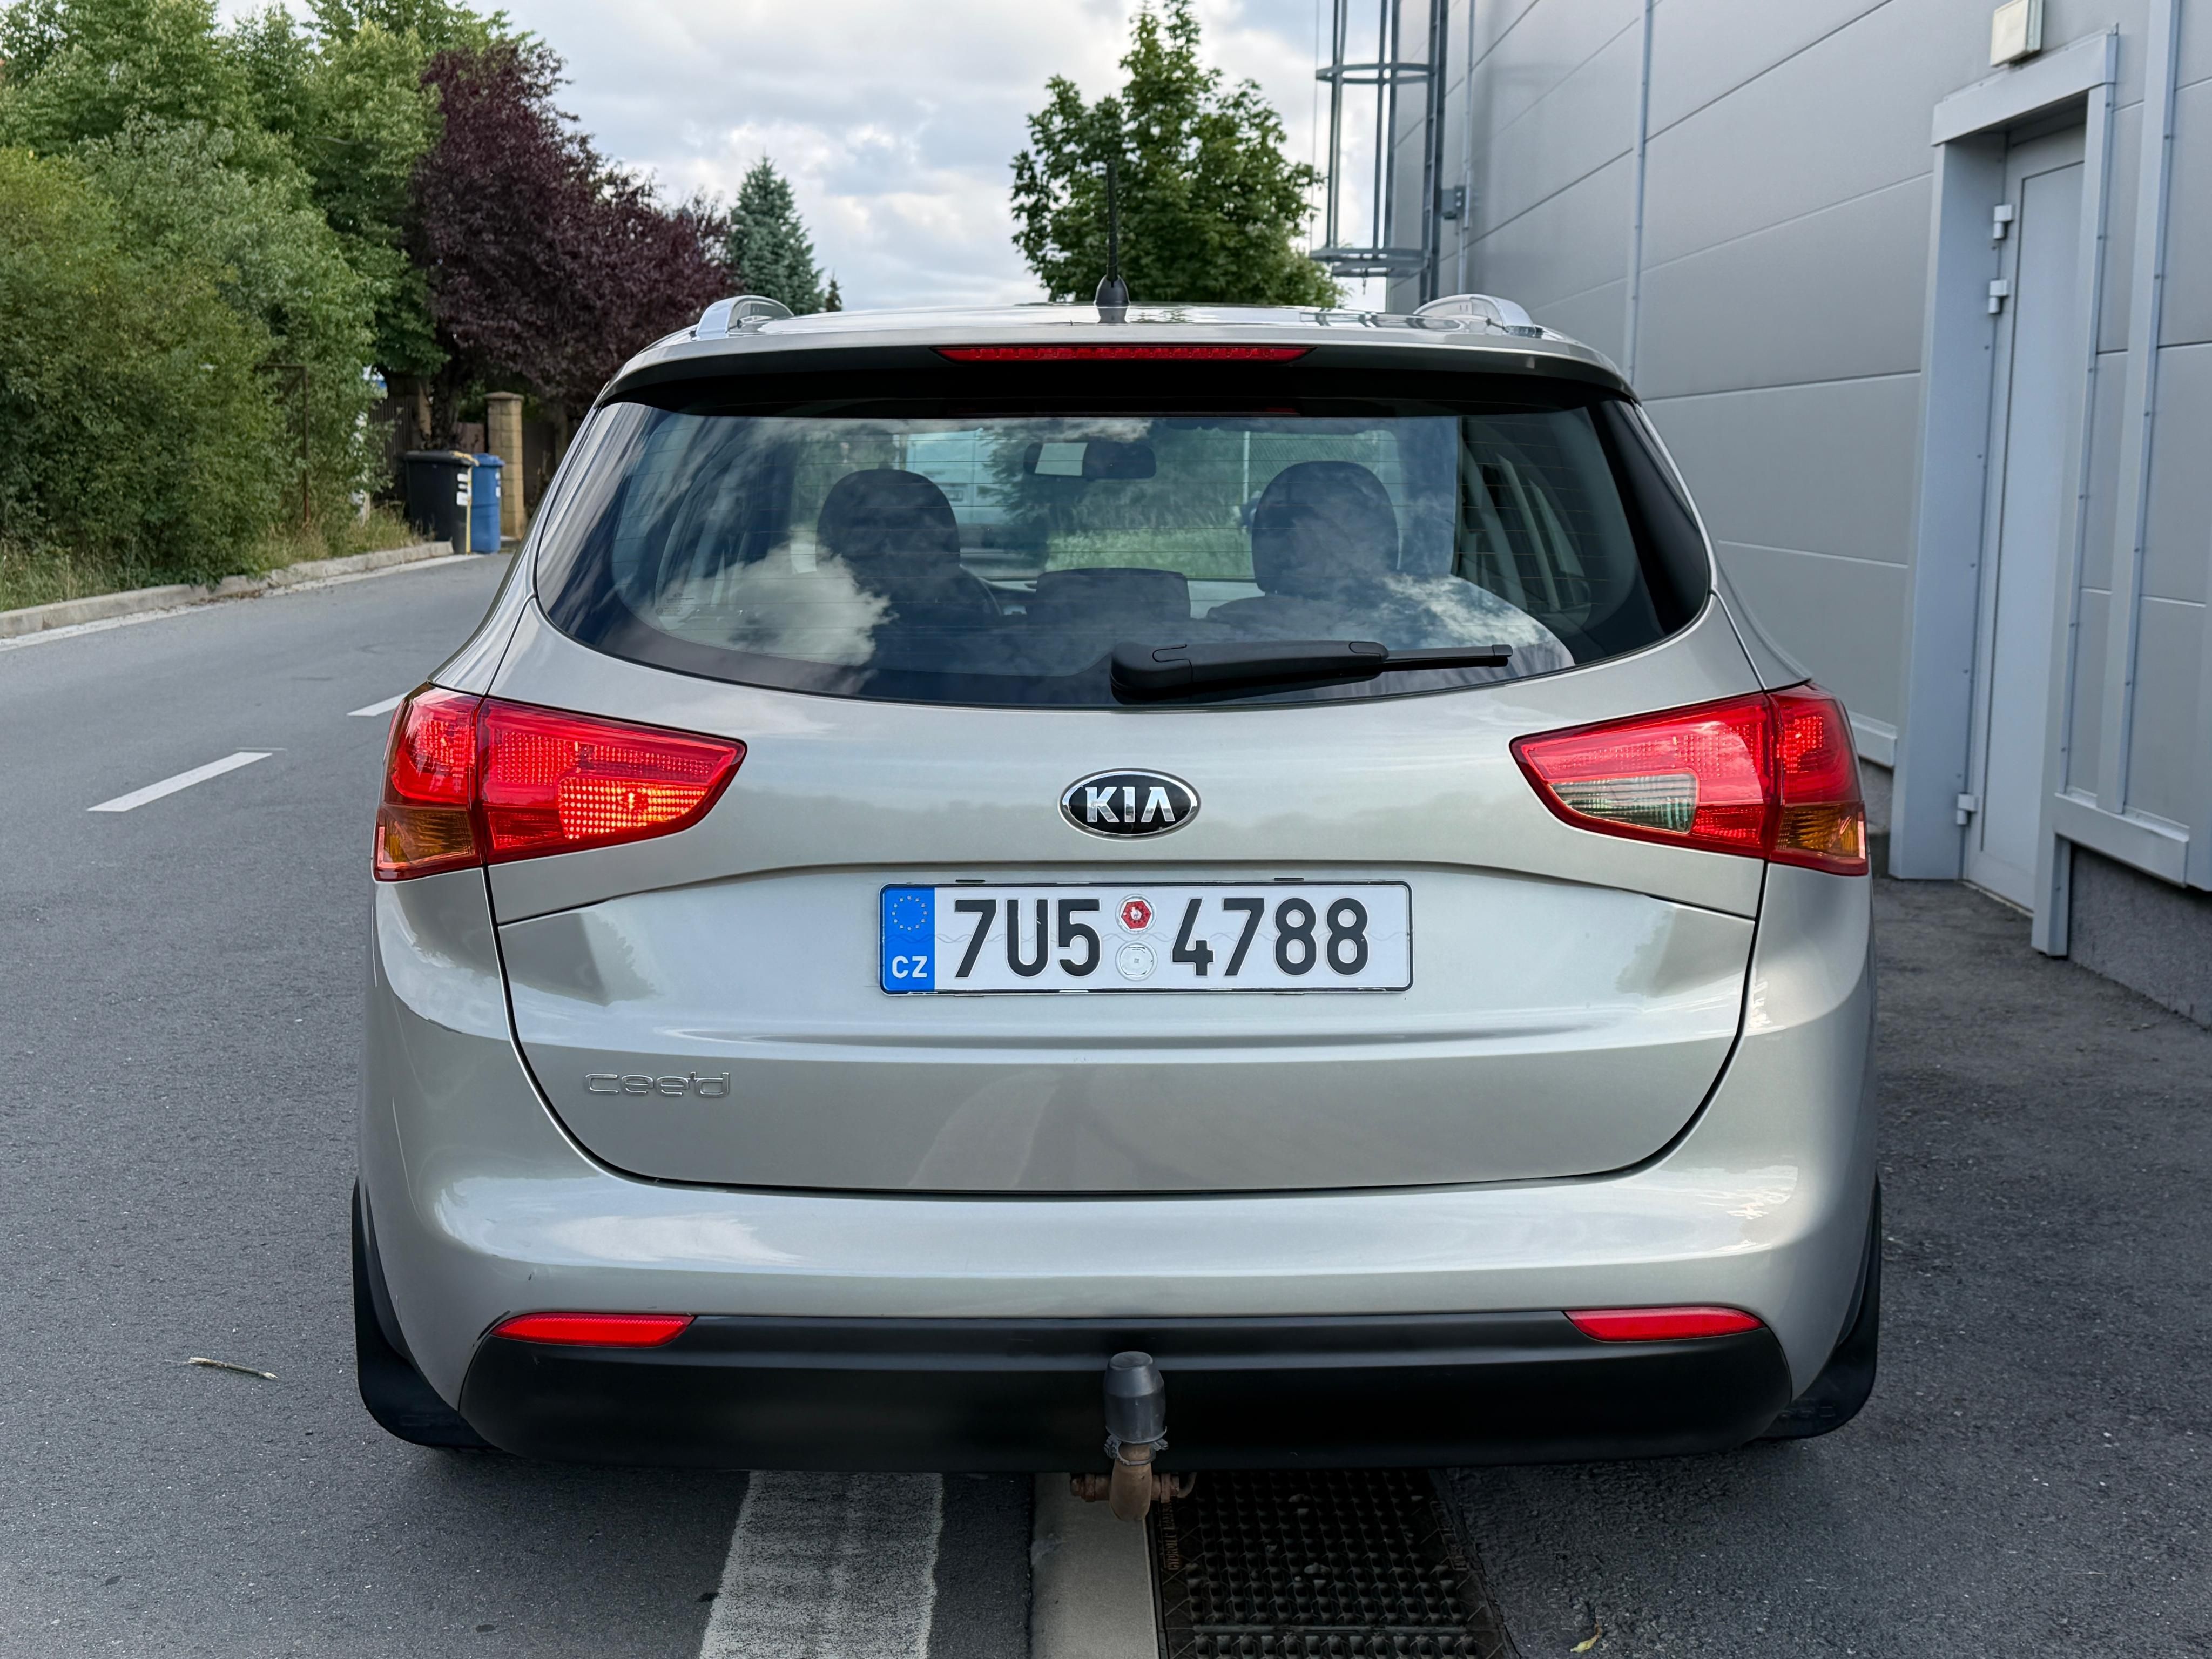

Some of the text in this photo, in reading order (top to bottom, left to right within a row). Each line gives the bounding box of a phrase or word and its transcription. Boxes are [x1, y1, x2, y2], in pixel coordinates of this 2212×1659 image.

[1084, 786, 1176, 823] KIA
[955, 898, 1369, 978] 7U5 4788
[892, 956, 927, 979] CZ
[584, 1071, 730, 1098] cee'd
